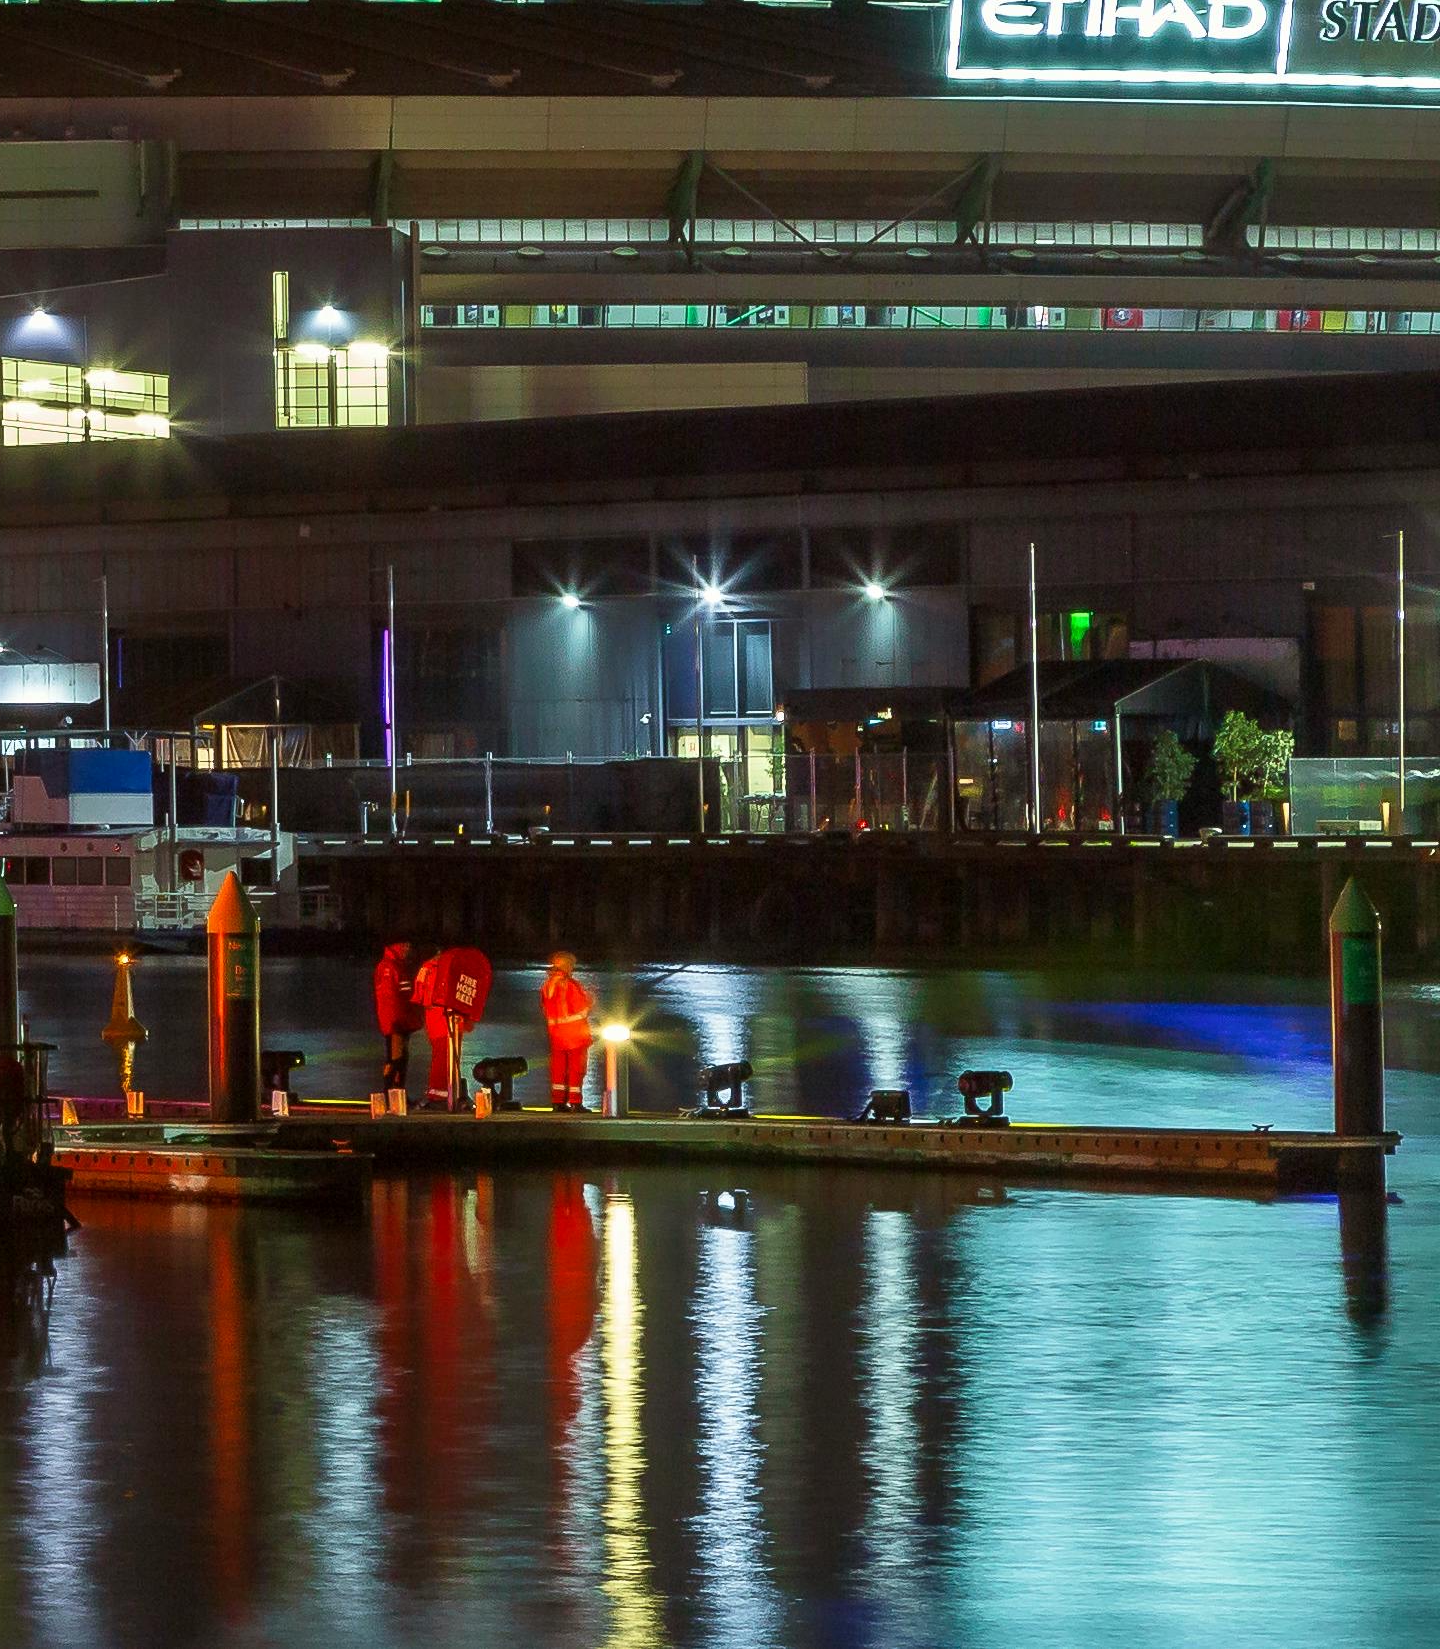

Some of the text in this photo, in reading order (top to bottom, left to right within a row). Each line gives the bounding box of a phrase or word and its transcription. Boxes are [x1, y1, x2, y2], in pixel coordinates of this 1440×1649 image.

[460, 974, 478, 988] FIRE
[456, 982, 478, 998] HOSE
[455, 991, 473, 1006] REEL
